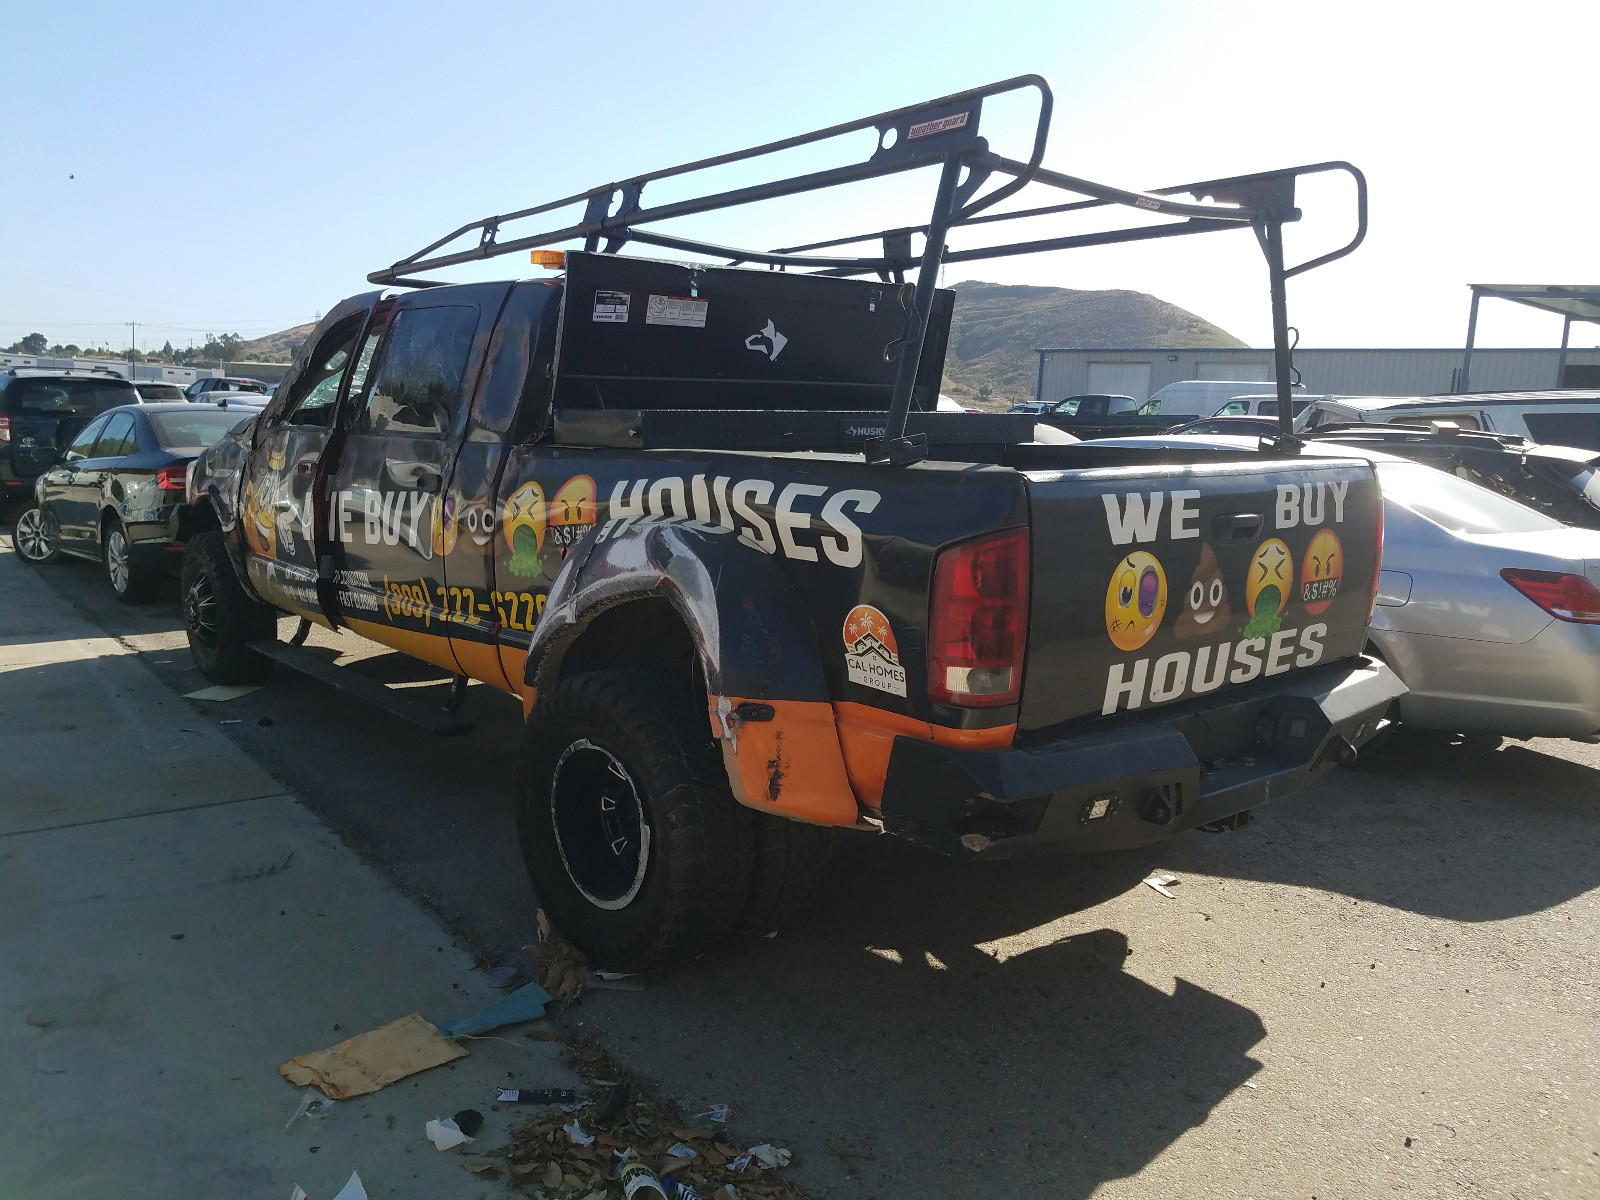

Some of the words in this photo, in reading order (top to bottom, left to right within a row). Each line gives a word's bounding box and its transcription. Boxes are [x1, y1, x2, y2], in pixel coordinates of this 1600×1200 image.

[365, 490, 430, 547] BUY
[595, 474, 881, 568] HOUSES
[1102, 490, 1200, 546] WE
[1275, 480, 1349, 529] BUY
[848, 658, 867, 672] CAL
[868, 663, 905, 683] HOMES
[863, 676, 892, 690] GROUP
[1101, 622, 1328, 716] HOUSES
